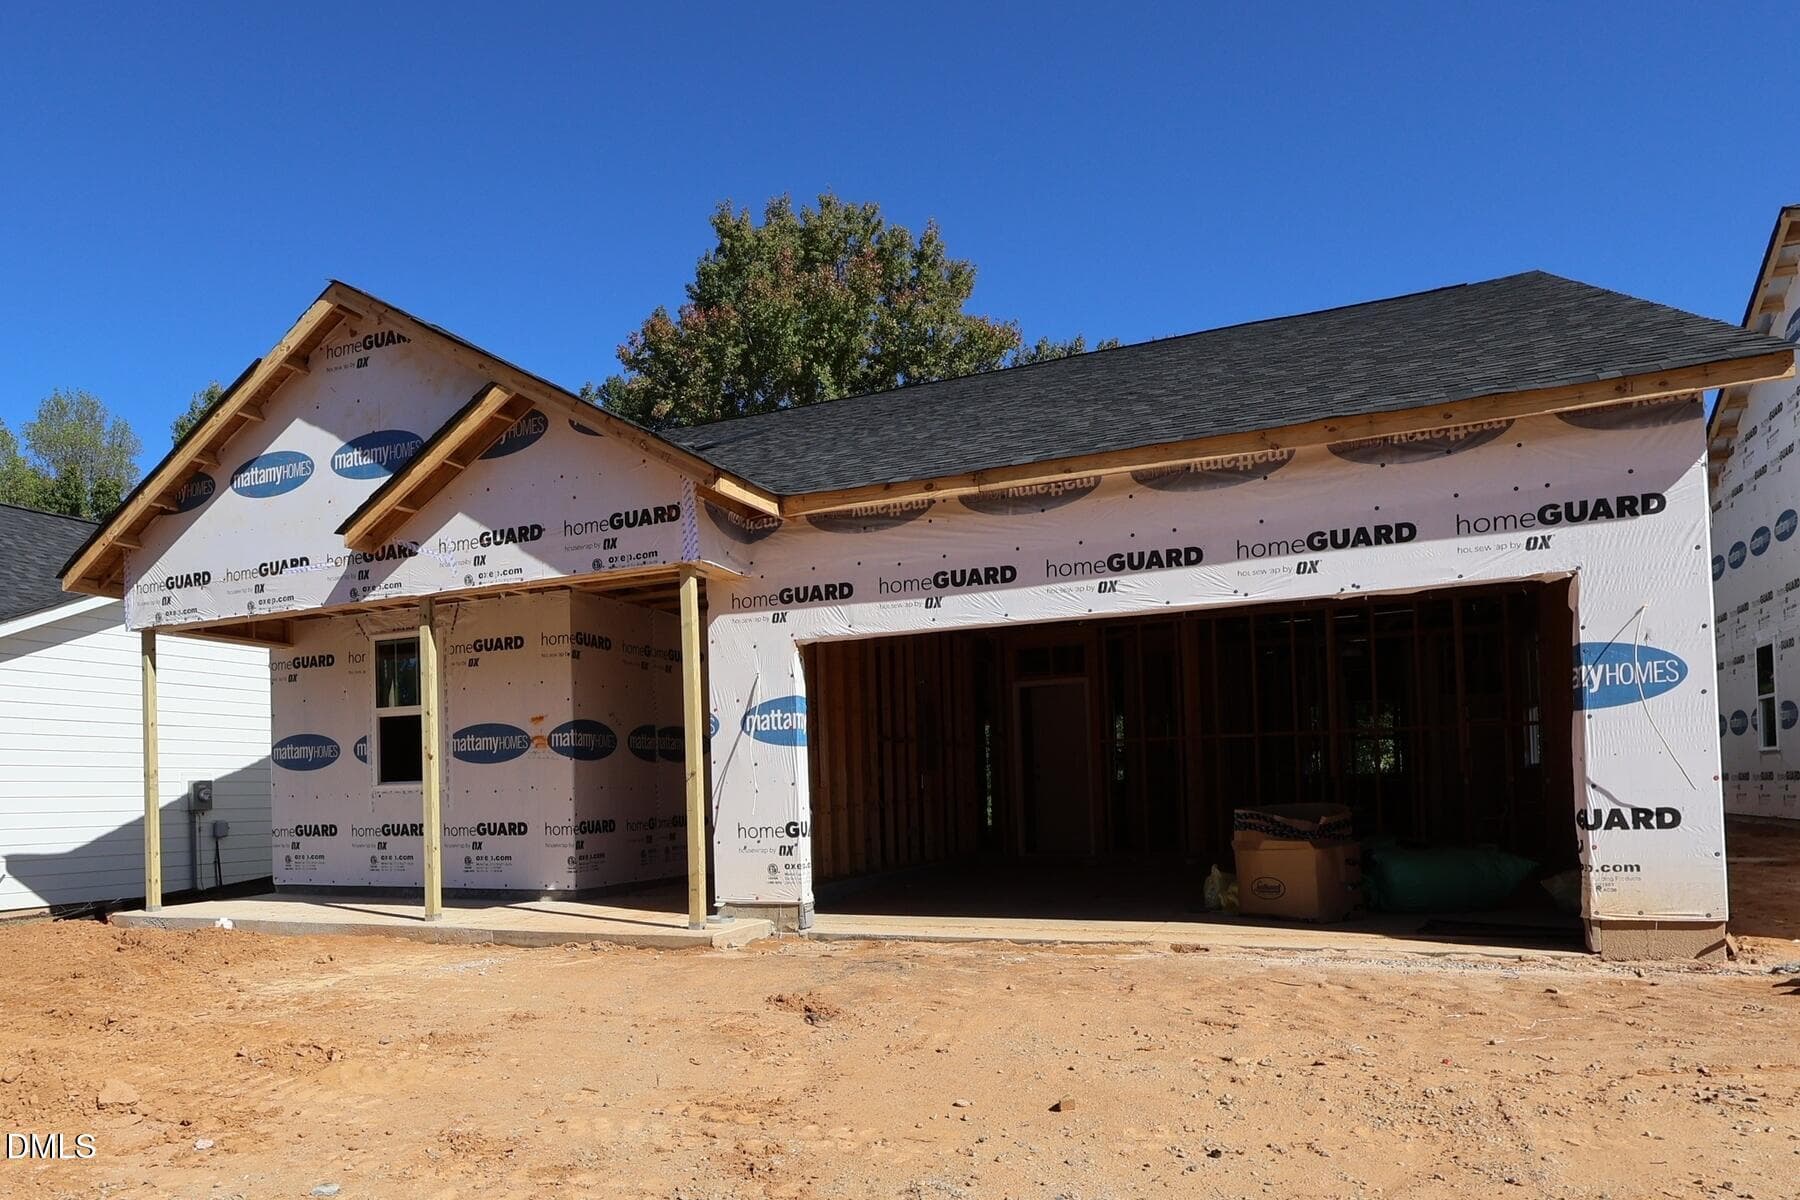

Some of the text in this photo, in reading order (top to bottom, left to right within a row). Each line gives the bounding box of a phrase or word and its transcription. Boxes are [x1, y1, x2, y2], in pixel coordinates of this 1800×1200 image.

[326, 330, 412, 359] homeGUAR
[233, 459, 313, 489] mattamyHOMES
[563, 503, 681, 538] homeGUARD
[1456, 491, 1666, 536] homeGUARD
[438, 523, 544, 555] homeGUARD
[602, 537, 618, 551] OX
[1236, 521, 1418, 560] homeGUARD
[1524, 534, 1553, 551] OX
[226, 556, 310, 583] homeGUARD
[473, 554, 487, 568] OX
[1046, 546, 1204, 578] homeGUARD
[1295, 559, 1321, 575] OX
[136, 570, 212, 595] homeGUARD
[357, 569, 370, 581] OX
[879, 565, 1017, 595] homeGUARD
[254, 583, 266, 594] OX
[732, 582, 854, 610] homeGUARD
[1097, 580, 1119, 594] OX
[161, 595, 172, 607] OX
[925, 596, 943, 609] OX
[772, 611, 789, 624] OX
[541, 631, 612, 651] homeGUARD
[271, 653, 335, 672] omeGUARD
[468, 657, 480, 668] OX
[452, 728, 529, 754] mattamyHOMES
[273, 742, 339, 762] mattamyHOMES
[272, 824, 338, 838] omeGUARD
[443, 821, 528, 838] homeGUARD
[545, 819, 616, 837] homeGUARD
[738, 821, 811, 839] homeGU
[779, 845, 795, 857] OX
